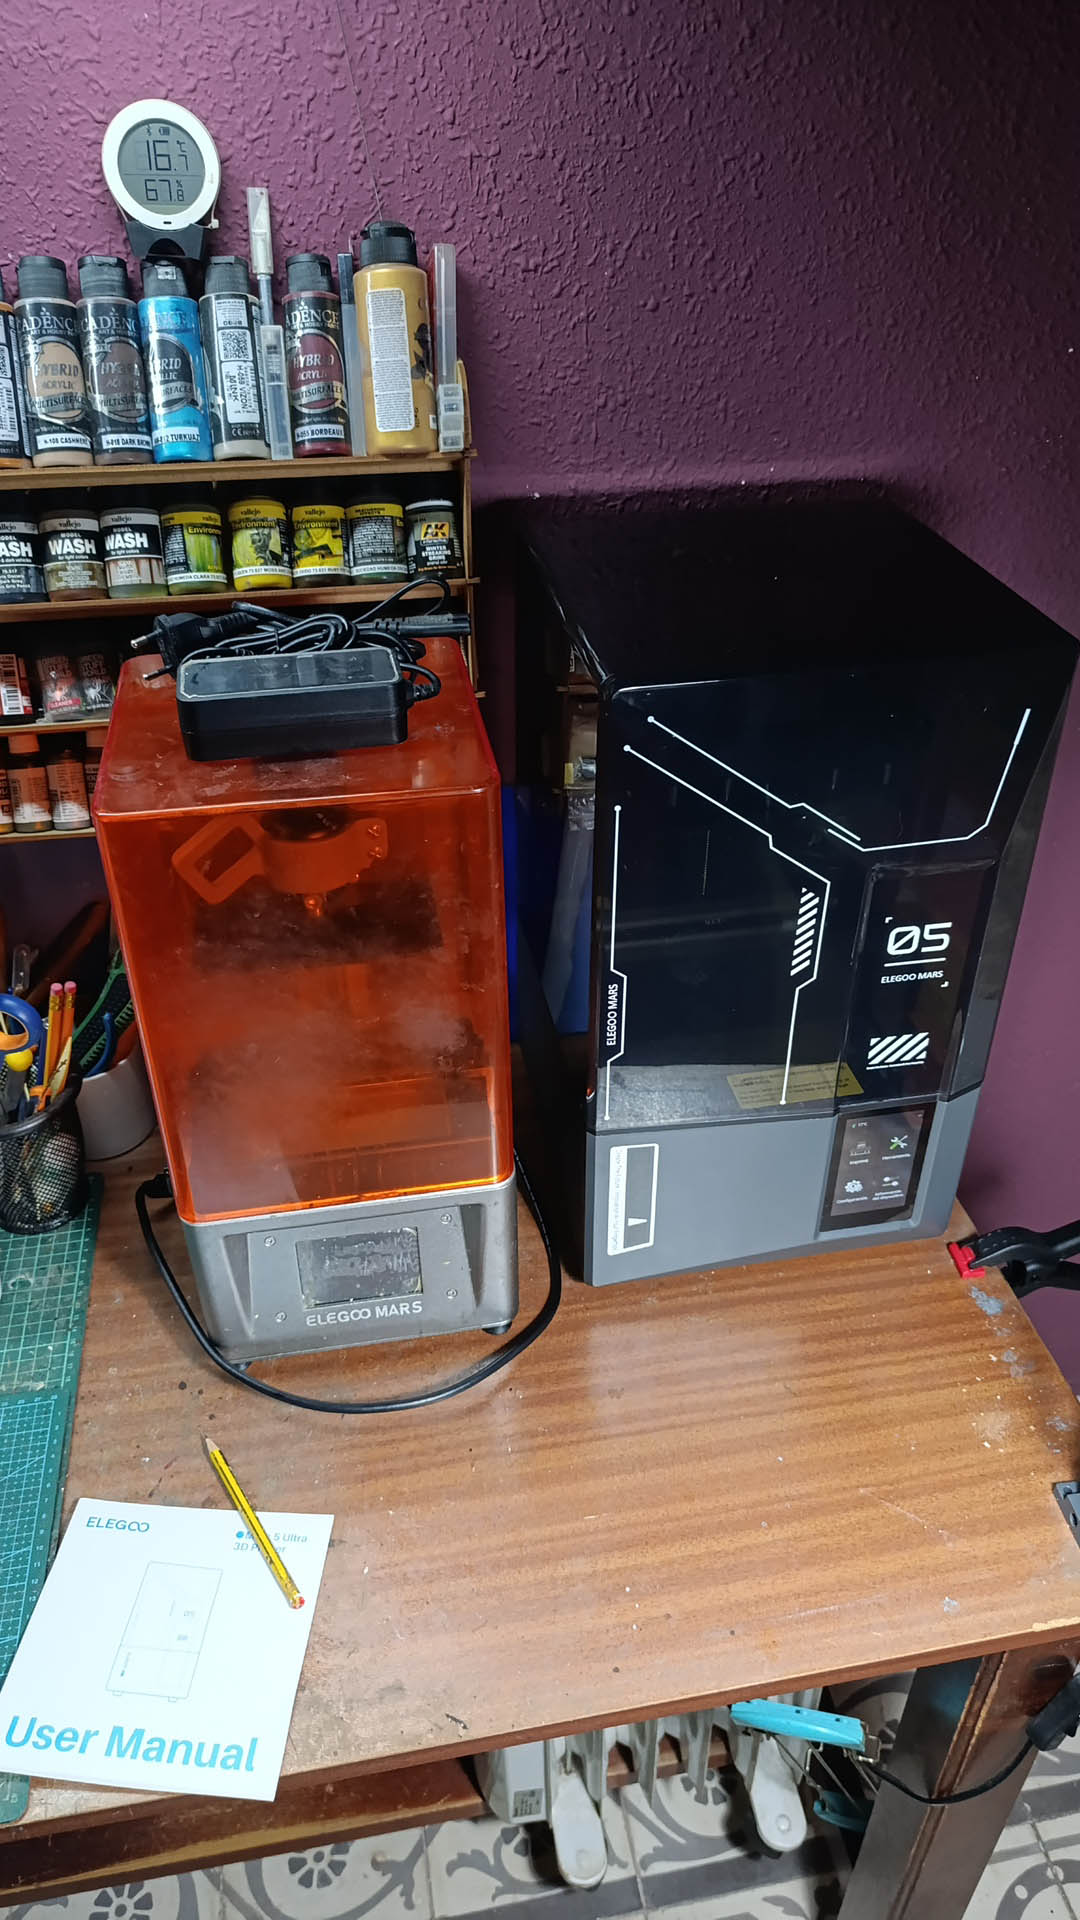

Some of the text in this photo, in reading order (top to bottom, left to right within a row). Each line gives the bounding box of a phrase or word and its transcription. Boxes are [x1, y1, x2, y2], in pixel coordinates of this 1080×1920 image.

[59, 520, 82, 529] vallejo
[0, 541, 33, 558] ASH
[48, 538, 97, 556] WASH
[104, 532, 149, 551] WASH
[881, 970, 944, 984] ELEGOO MARS
[606, 983, 619, 1046] ELEGOO MARS
[306, 1301, 423, 1327] ELEGOO MARS
[86, 1516, 150, 1533] ELEGOO
[233, 1542, 249, 1551] 3D
[282, 1533, 307, 1543] Ultra
[5, 1714, 259, 1772] User Manual
